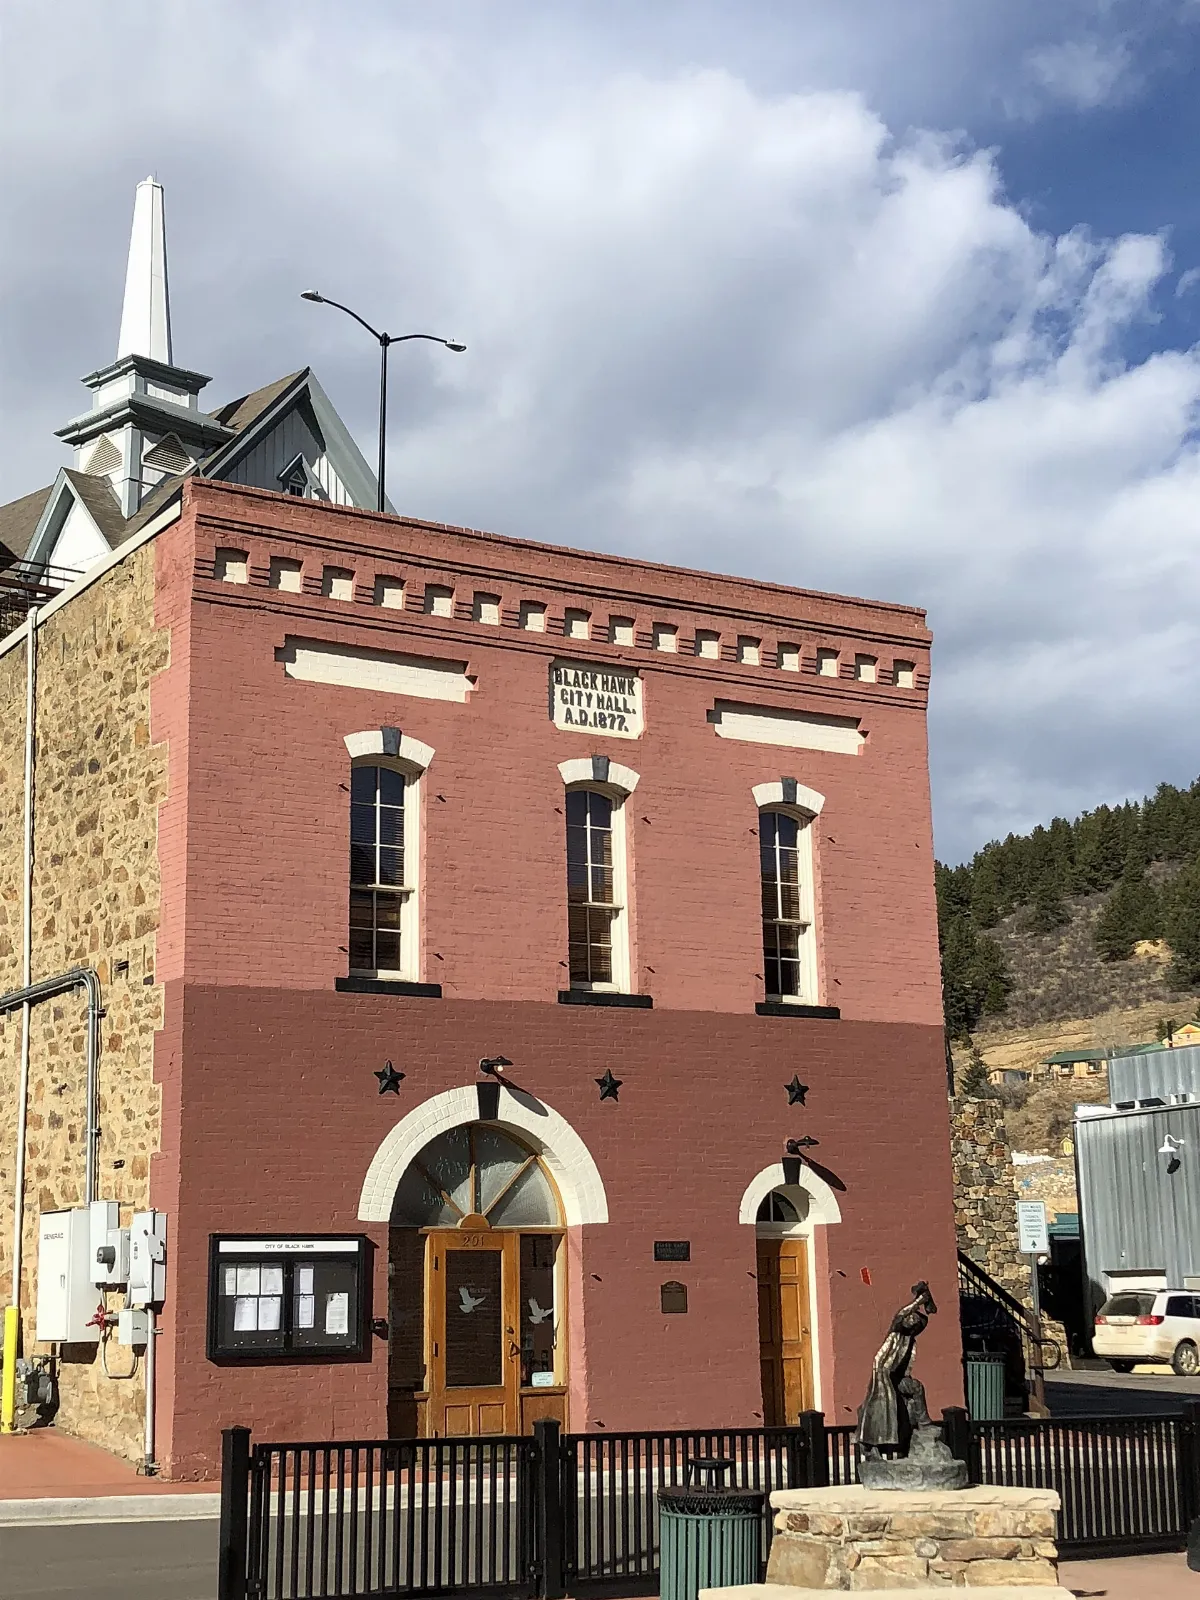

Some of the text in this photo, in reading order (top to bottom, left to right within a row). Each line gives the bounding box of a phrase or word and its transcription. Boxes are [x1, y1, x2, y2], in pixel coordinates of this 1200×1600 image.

[554, 667, 635, 696] BLACK HAWK
[560, 688, 636, 714] CITY HALL.
[463, 1235, 484, 1247] 201
